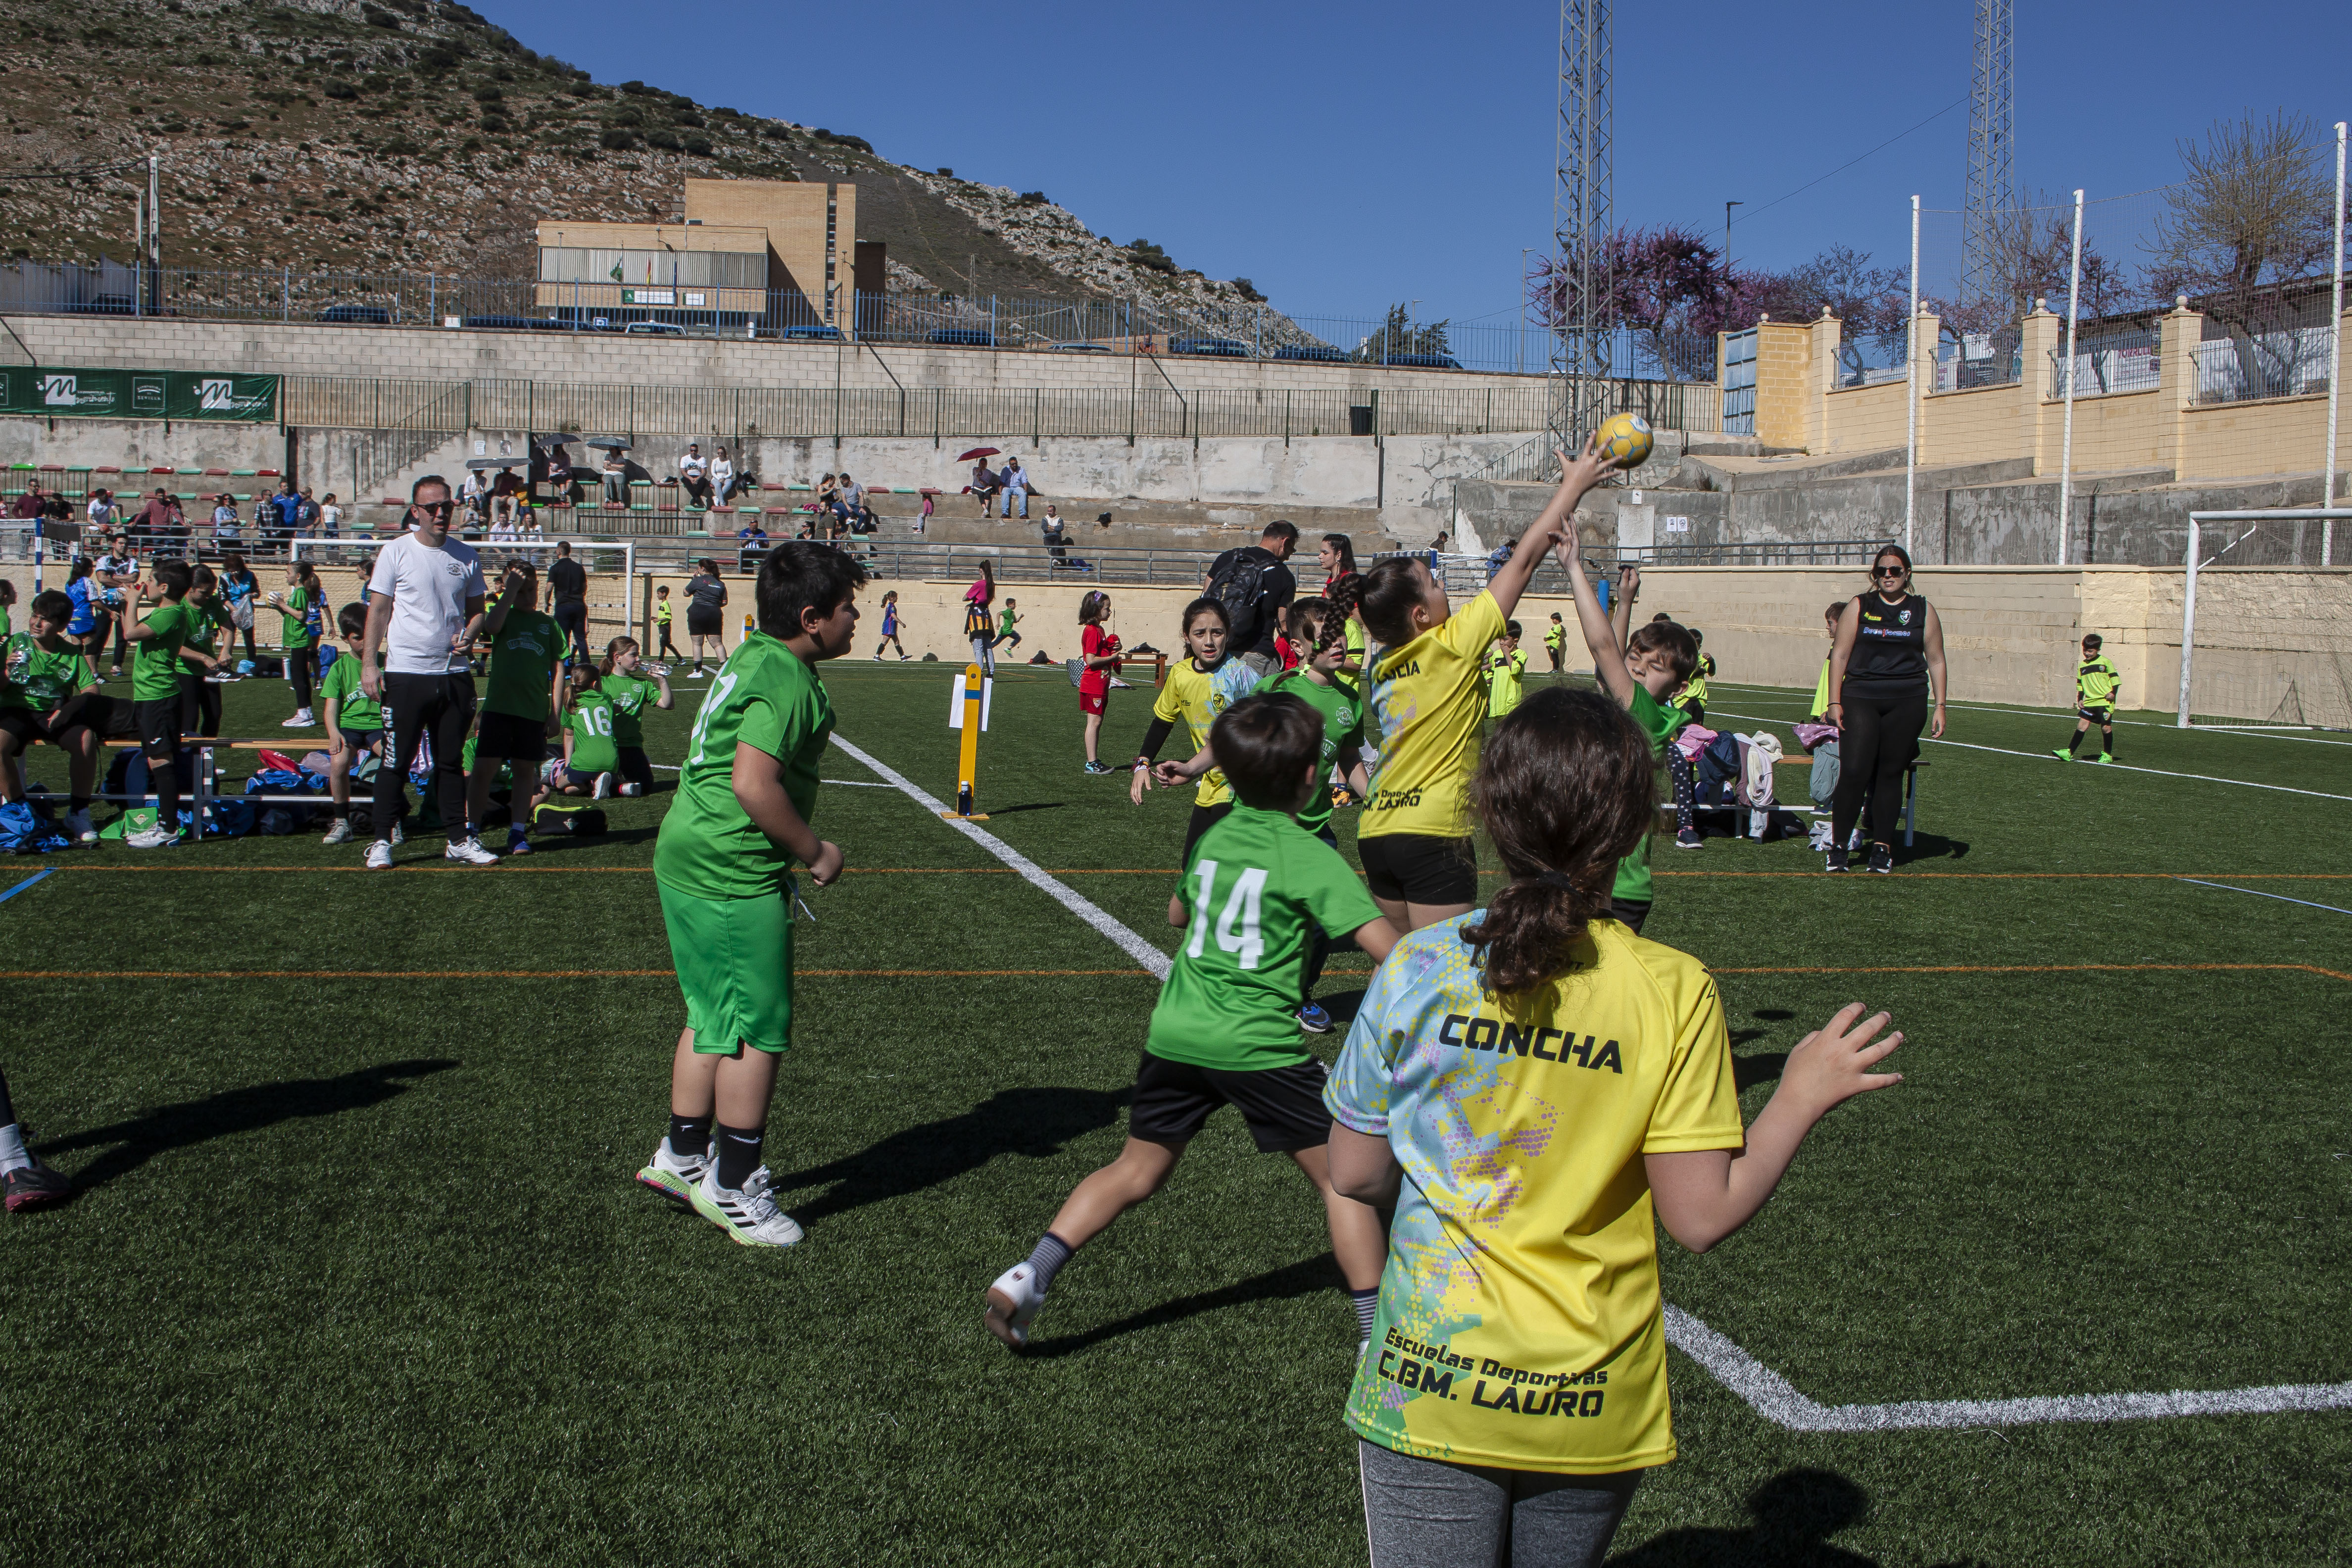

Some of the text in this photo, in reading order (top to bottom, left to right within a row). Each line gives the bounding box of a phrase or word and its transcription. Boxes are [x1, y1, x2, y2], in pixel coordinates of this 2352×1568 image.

[578, 706, 611, 736] 16
[1185, 859, 1270, 969] 14
[1438, 1014, 1623, 1075] CONCHA
[1384, 1326, 1609, 1386] Escuelas Deportivas
[1470, 1379, 1605, 1418] LAURO
